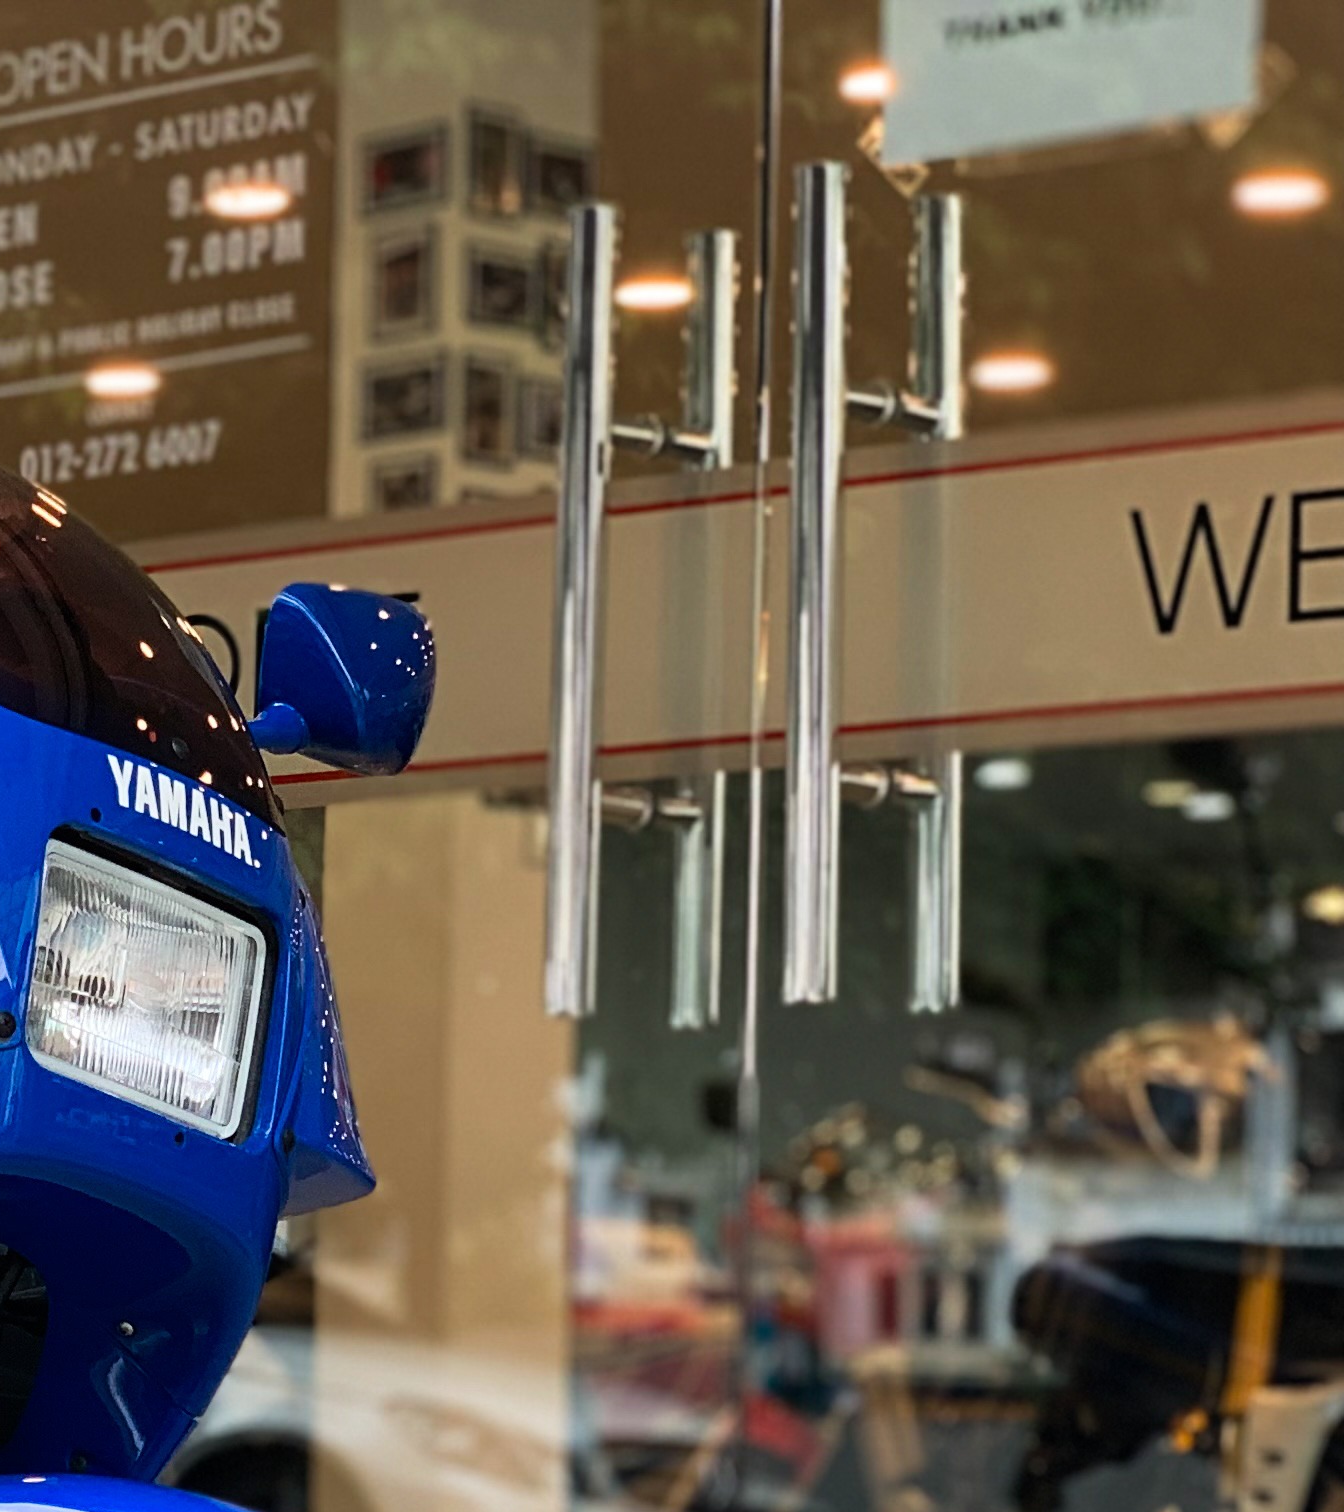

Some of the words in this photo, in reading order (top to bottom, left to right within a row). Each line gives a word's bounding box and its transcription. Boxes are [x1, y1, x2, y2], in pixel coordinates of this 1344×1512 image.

[120, 0, 283, 80] HOURS
[133, 91, 315, 160] SATURDAY
[166, 218, 305, 284] 7.00PM
[20, 429, 140, 484] 012-272
[145, 418, 221, 471] 6007
